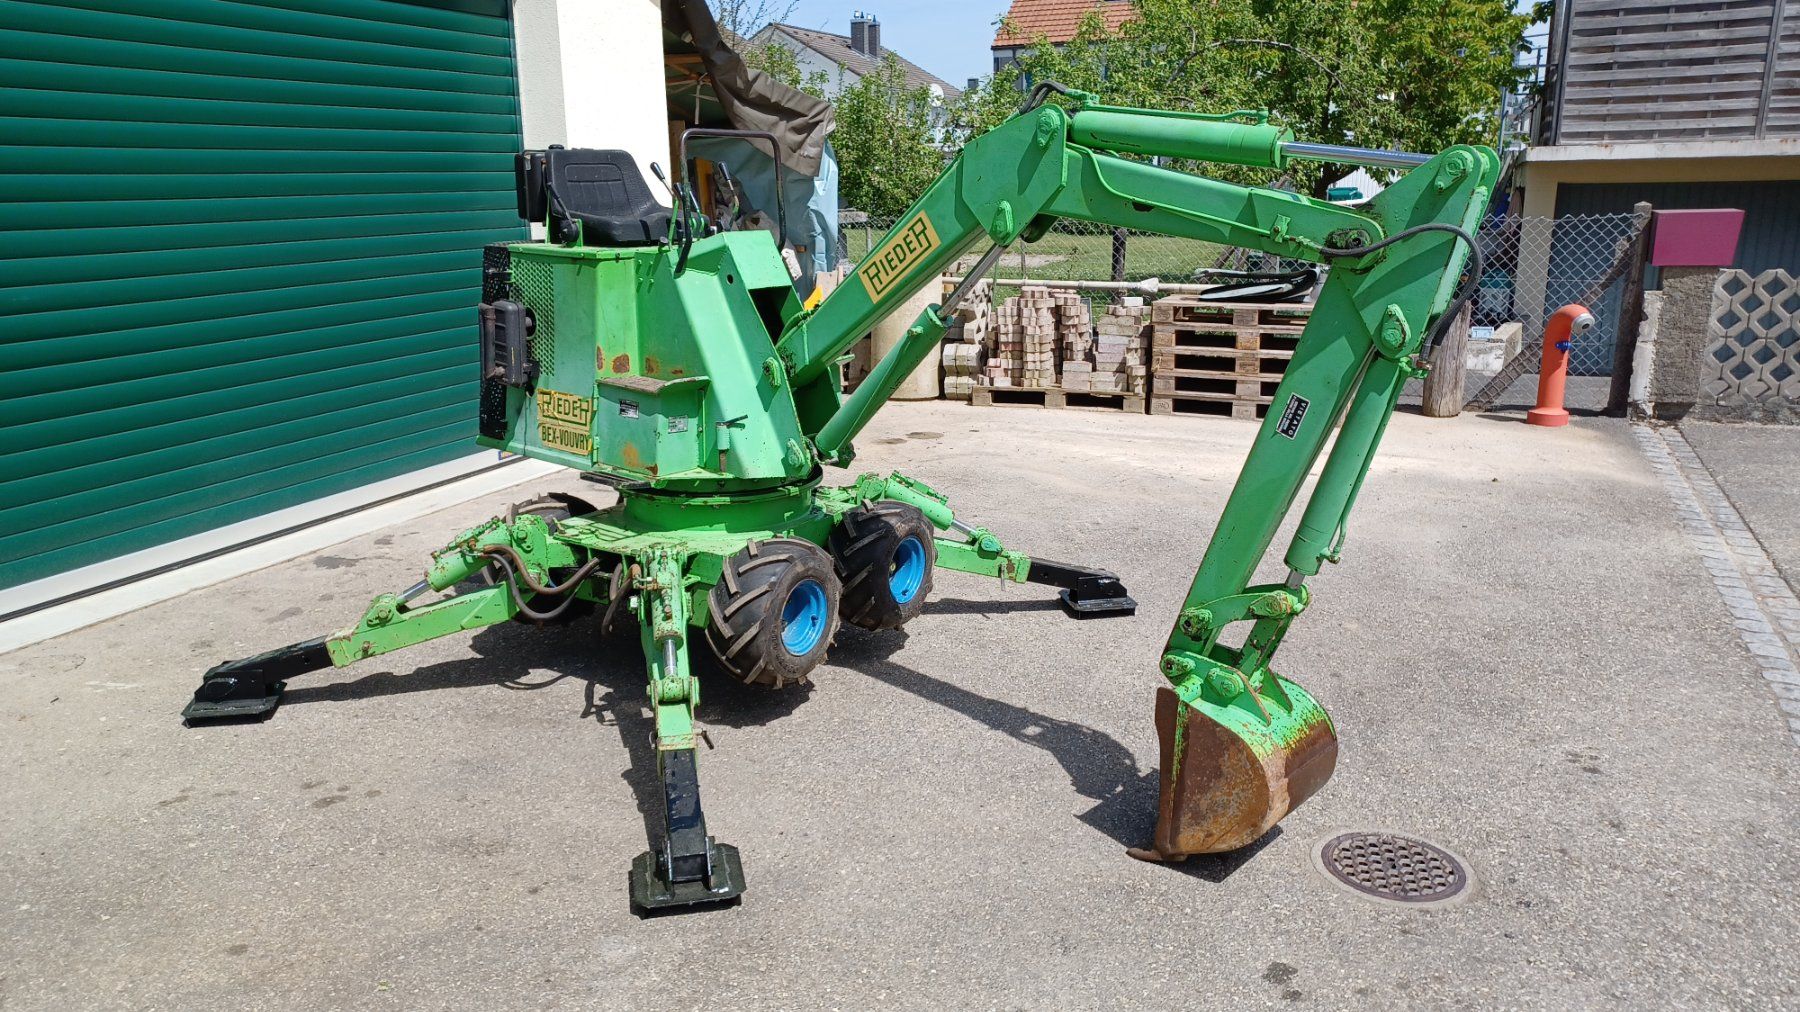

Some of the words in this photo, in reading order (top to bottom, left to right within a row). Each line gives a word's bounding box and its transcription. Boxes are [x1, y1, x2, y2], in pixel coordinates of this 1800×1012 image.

[862, 217, 932, 295] RIEDER
[540, 392, 589, 426] RIEDER
[1288, 402, 1307, 435] VIETATO
[541, 425, 588, 451] BEX-VOUVRY
